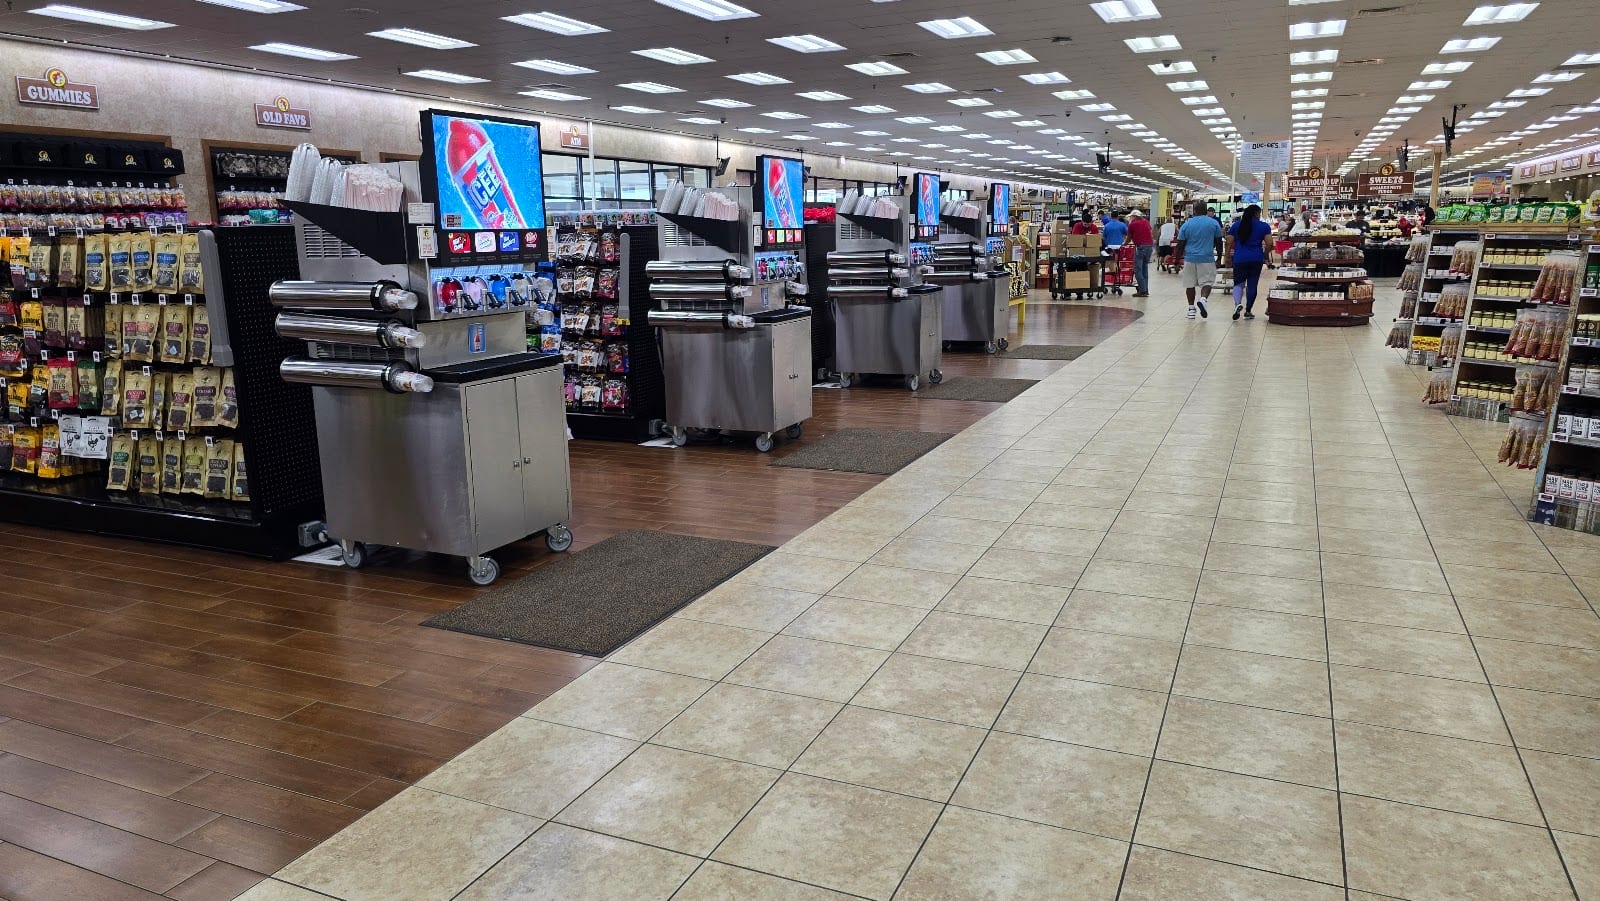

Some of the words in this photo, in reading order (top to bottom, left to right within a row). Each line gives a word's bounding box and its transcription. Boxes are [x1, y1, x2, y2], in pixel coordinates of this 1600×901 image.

[27, 86, 92, 105] GUMMIES
[262, 111, 283, 124] OLD
[284, 113, 307, 126] FAVS
[571, 136, 581, 145] ATM
[1289, 179, 1308, 187] TEXAS
[1369, 176, 1404, 184] SWEETS
[466, 162, 502, 212] ICEE
